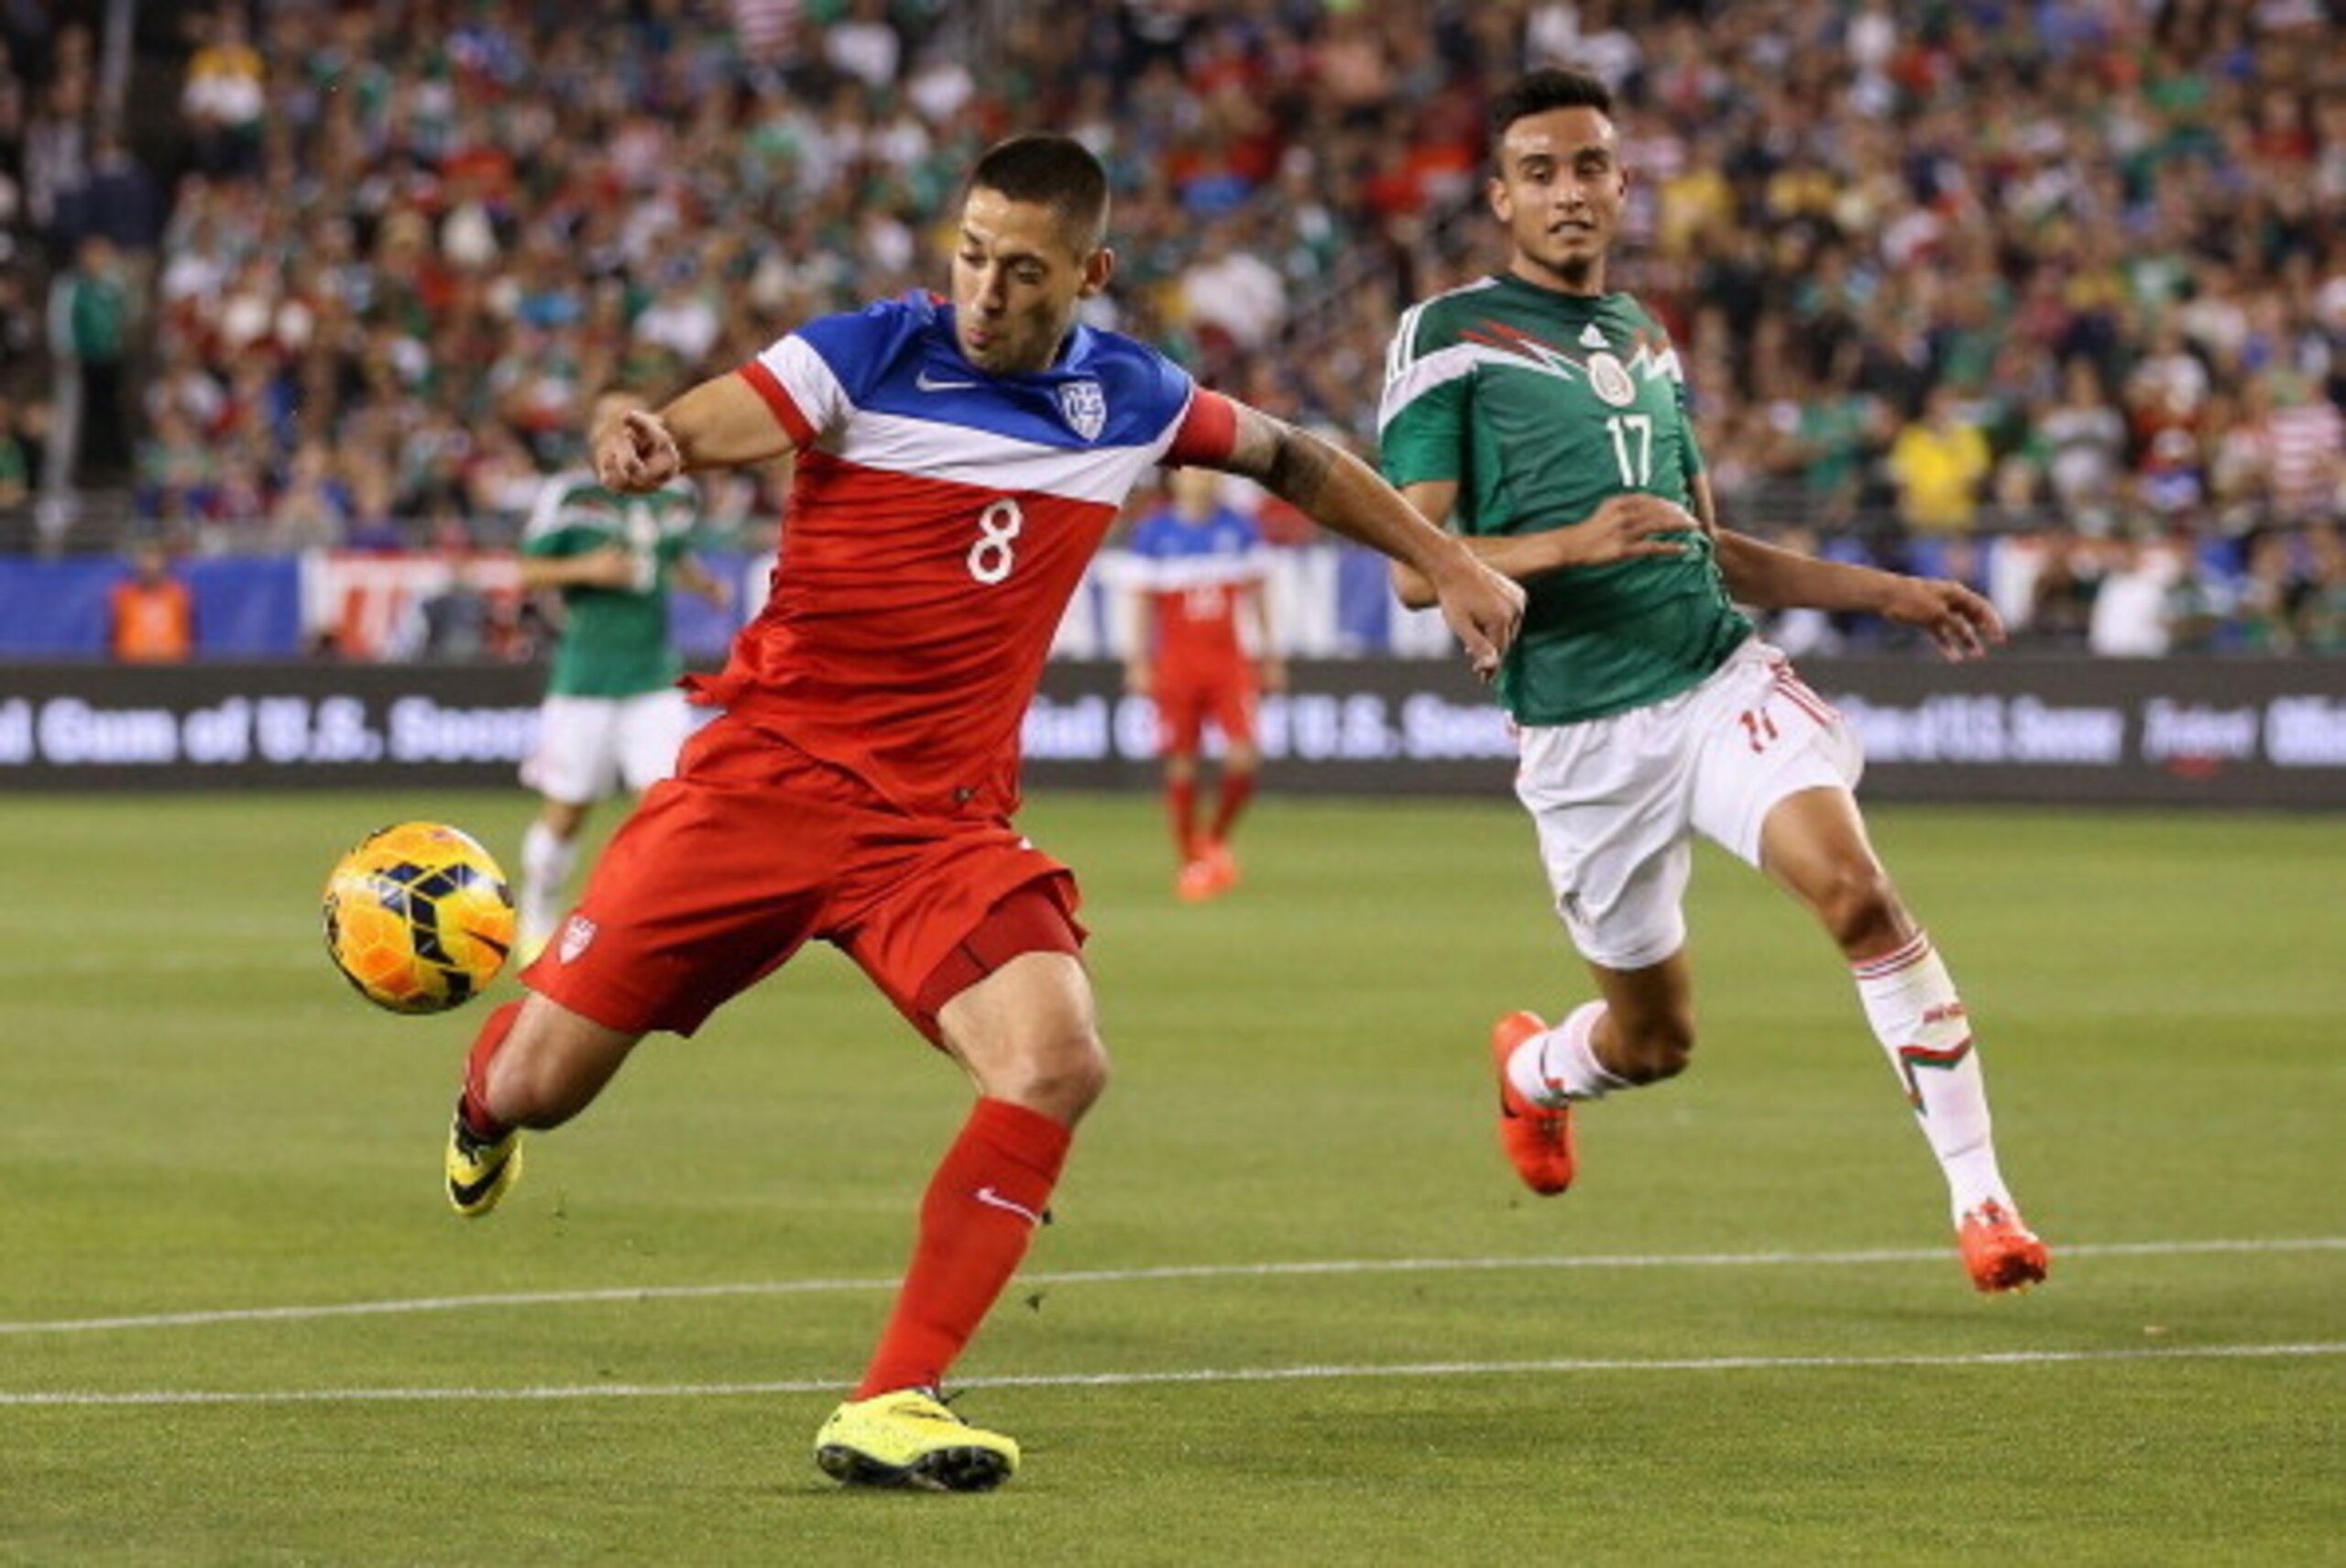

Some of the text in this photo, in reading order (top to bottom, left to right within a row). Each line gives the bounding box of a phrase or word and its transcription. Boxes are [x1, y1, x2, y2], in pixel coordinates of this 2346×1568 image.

[1606, 414, 1651, 488] 17
[966, 497, 1024, 586] 8
[389, 696, 543, 763] Socc
